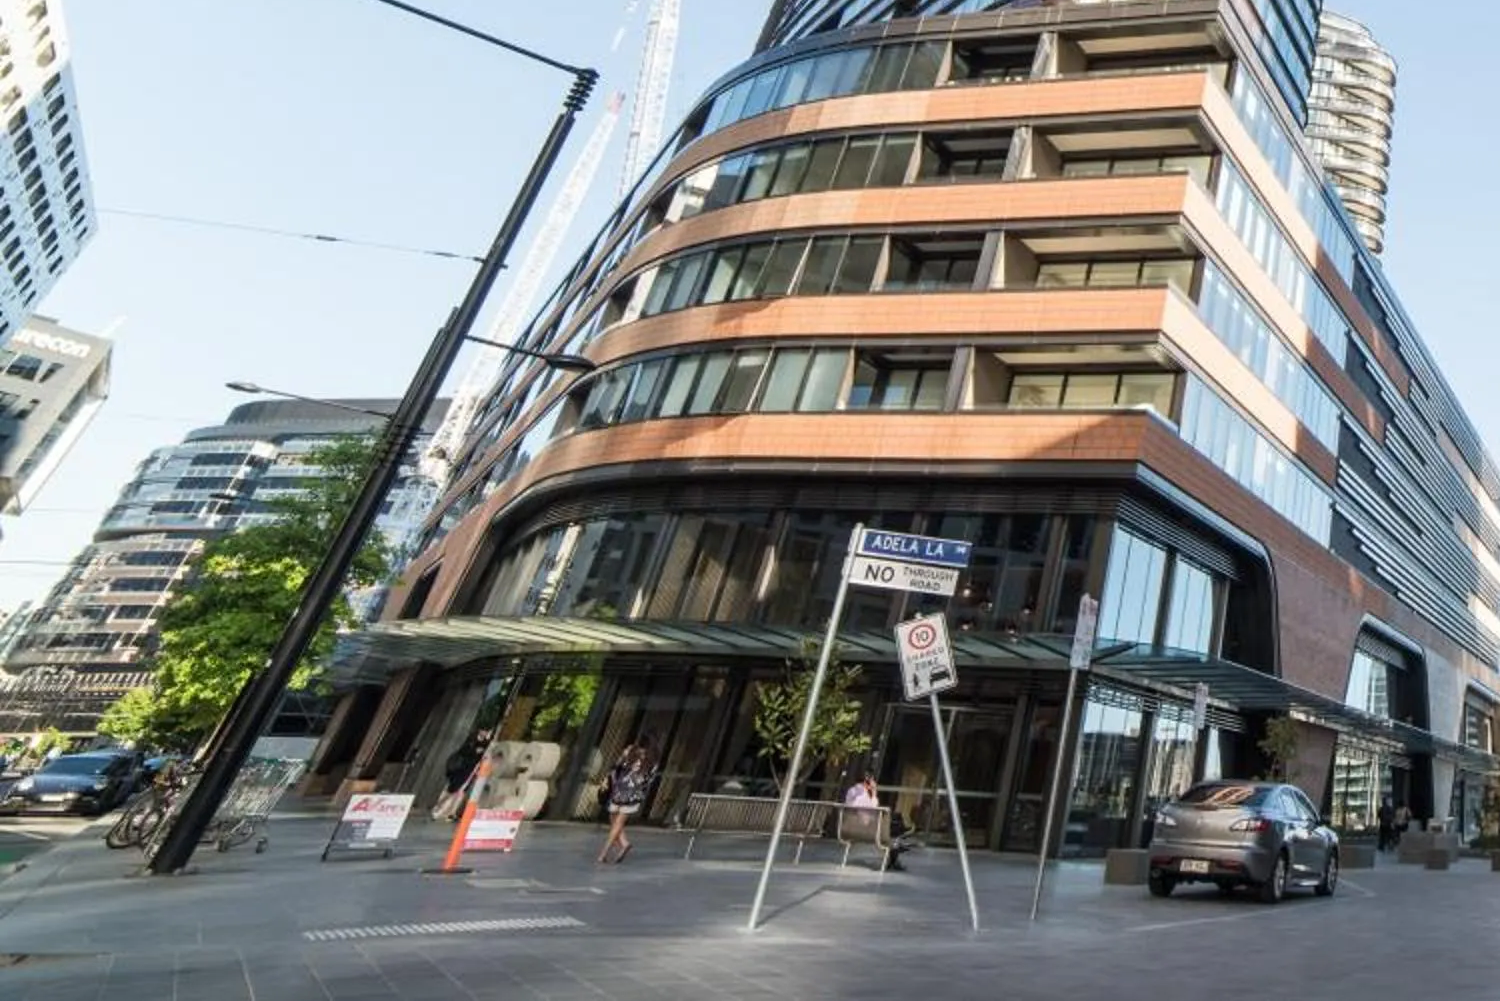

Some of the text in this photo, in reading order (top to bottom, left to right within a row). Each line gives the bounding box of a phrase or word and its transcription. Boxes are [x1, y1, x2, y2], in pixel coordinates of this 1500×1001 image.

[871, 535, 945, 557] ADELA LA
[864, 564, 955, 583] NO THROUGH
[909, 578, 941, 592] ROAD
[915, 630, 929, 644] 10
